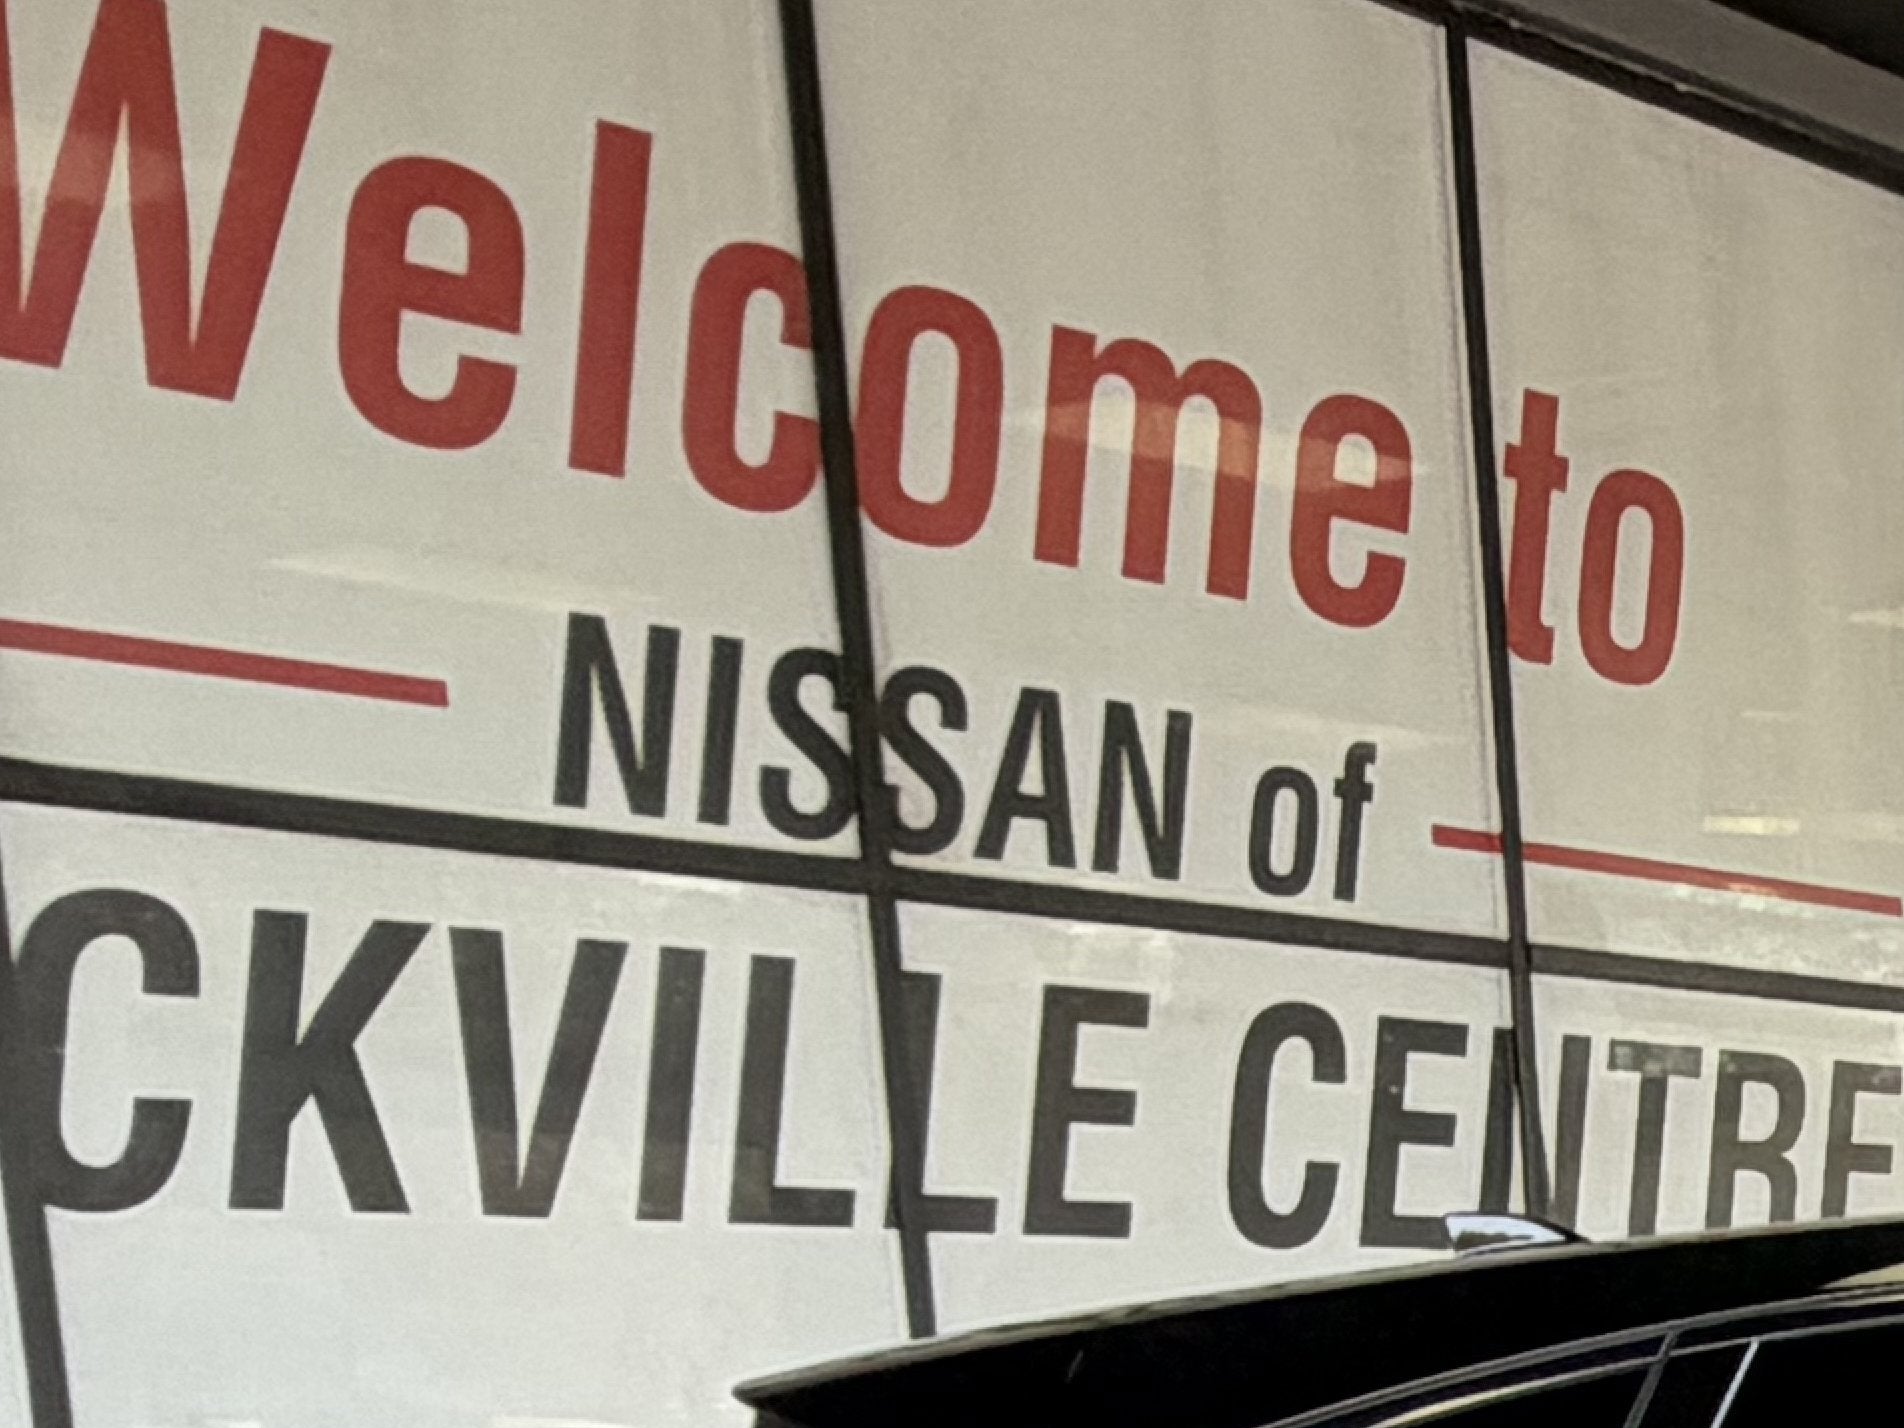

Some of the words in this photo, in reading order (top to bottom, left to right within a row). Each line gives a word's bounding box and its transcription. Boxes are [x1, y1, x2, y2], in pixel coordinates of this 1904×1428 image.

[0, 0, 1412, 628] Welcome
[1505, 387, 1684, 685] to
[553, 611, 1193, 880] NISSAN
[1247, 740, 1378, 902] of
[1227, 1001, 1902, 1251] CENTRE
